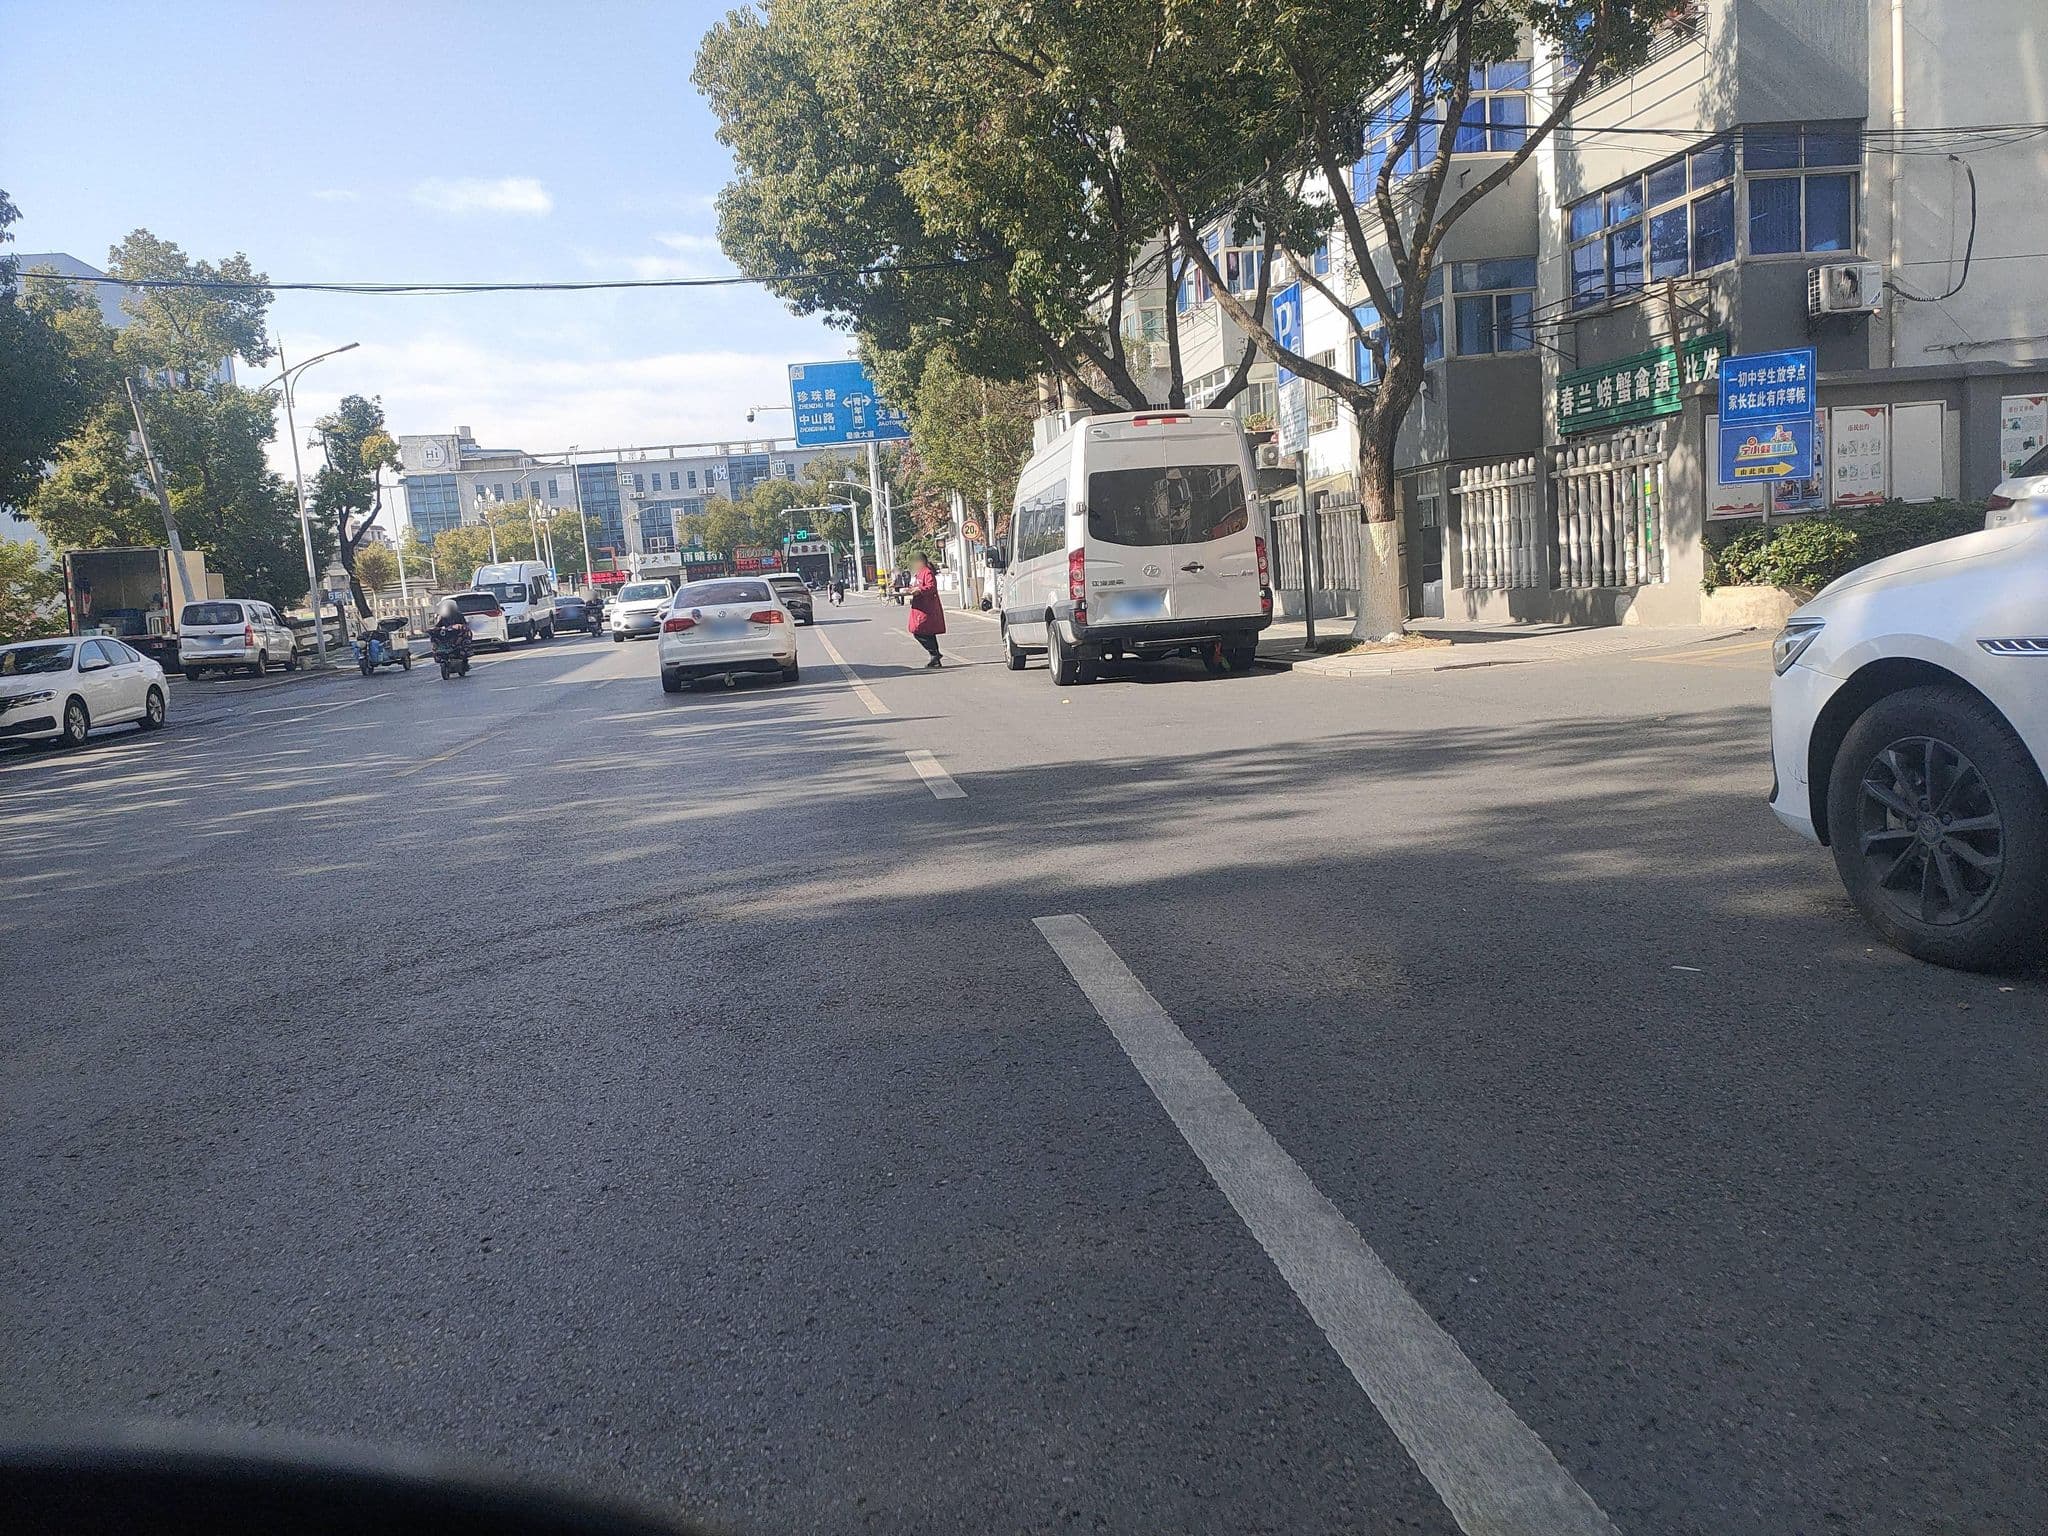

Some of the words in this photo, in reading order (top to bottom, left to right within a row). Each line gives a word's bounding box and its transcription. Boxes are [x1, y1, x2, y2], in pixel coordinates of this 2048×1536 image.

[1728, 364, 1807, 388] 一初中学生放学点
[797, 388, 836, 403] 珍珠路
[1728, 386, 1806, 411] 家长在此有序等候
[799, 412, 835, 426] 中山路
[796, 530, 807, 540] 20
